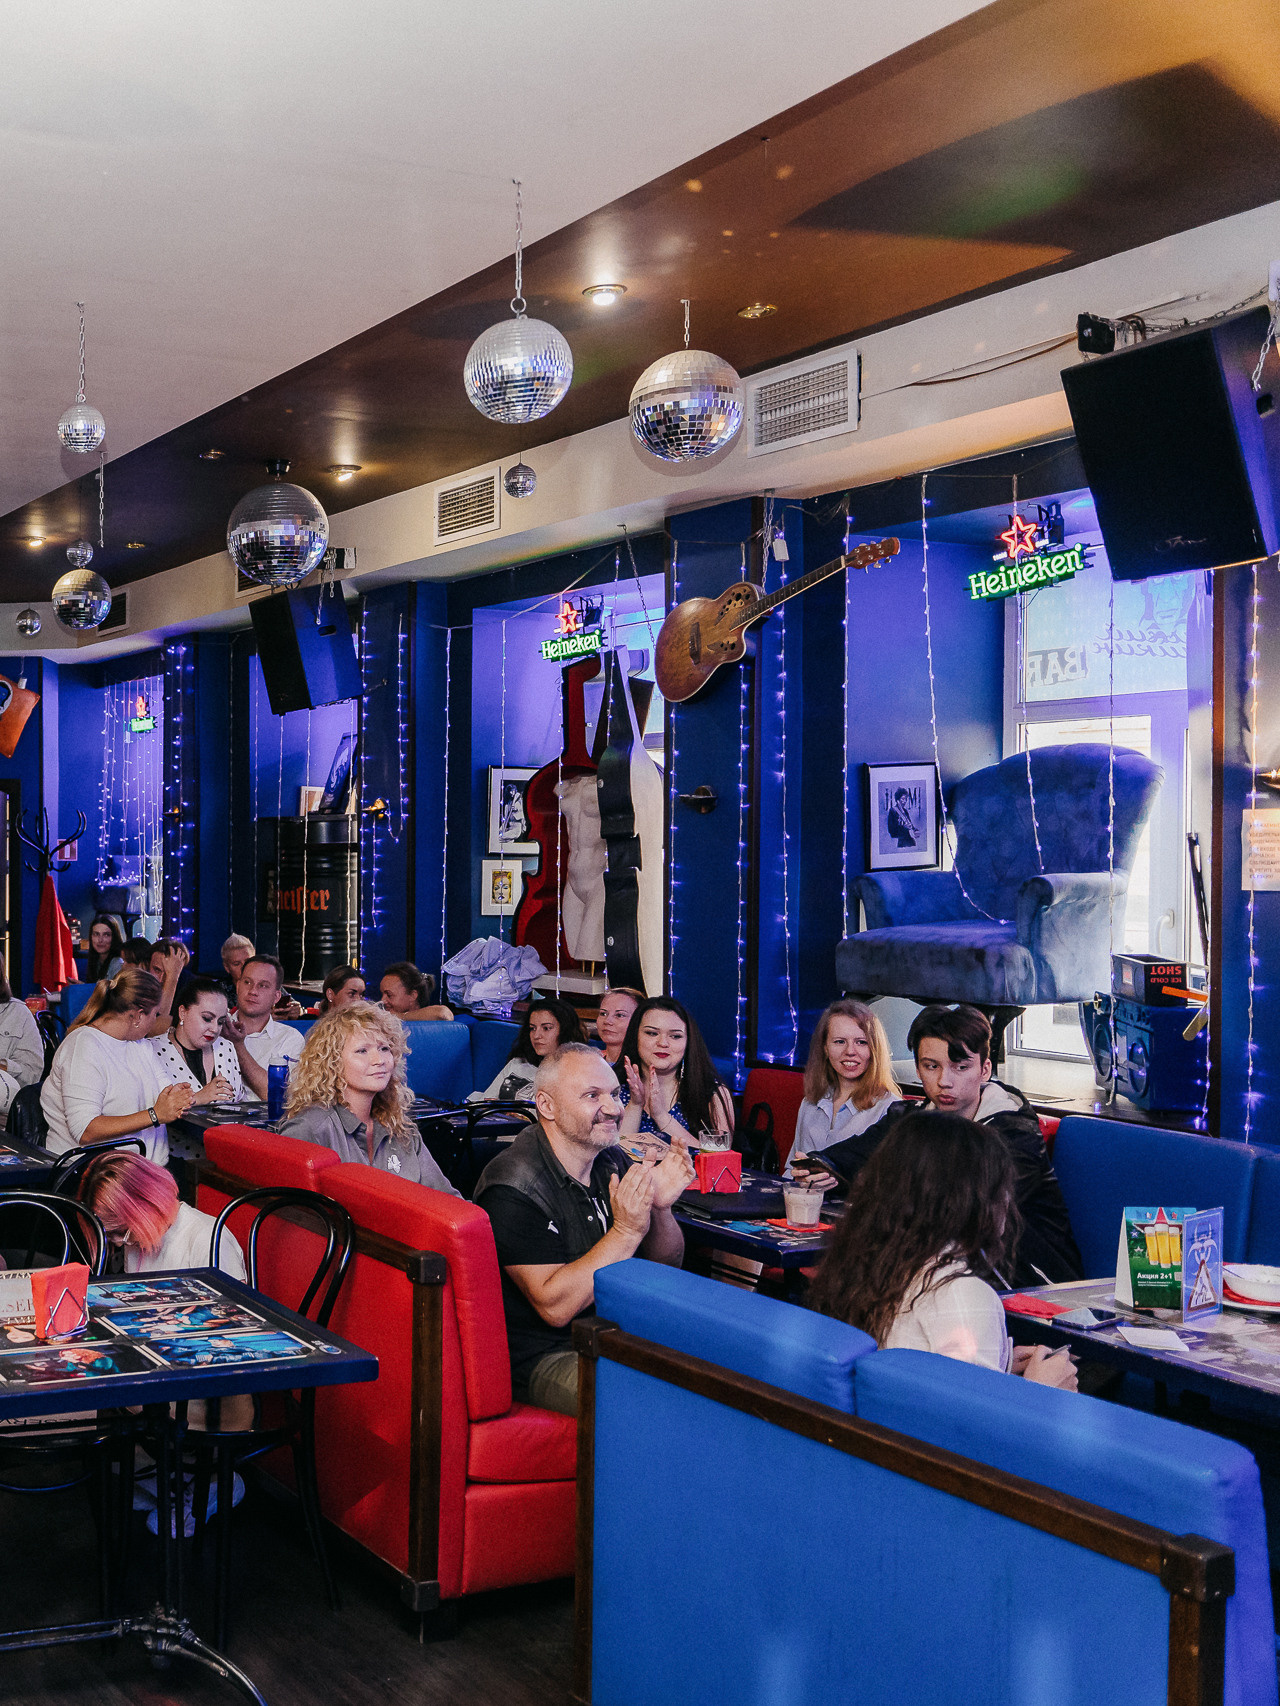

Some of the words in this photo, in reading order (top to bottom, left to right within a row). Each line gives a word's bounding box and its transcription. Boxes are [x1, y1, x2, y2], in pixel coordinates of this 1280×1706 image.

[968, 546, 1084, 599] Heineken
[540, 631, 602, 660] Heineken
[1150, 965, 1182, 975] SHOT
[1138, 1272, 1158, 1280] Акция
